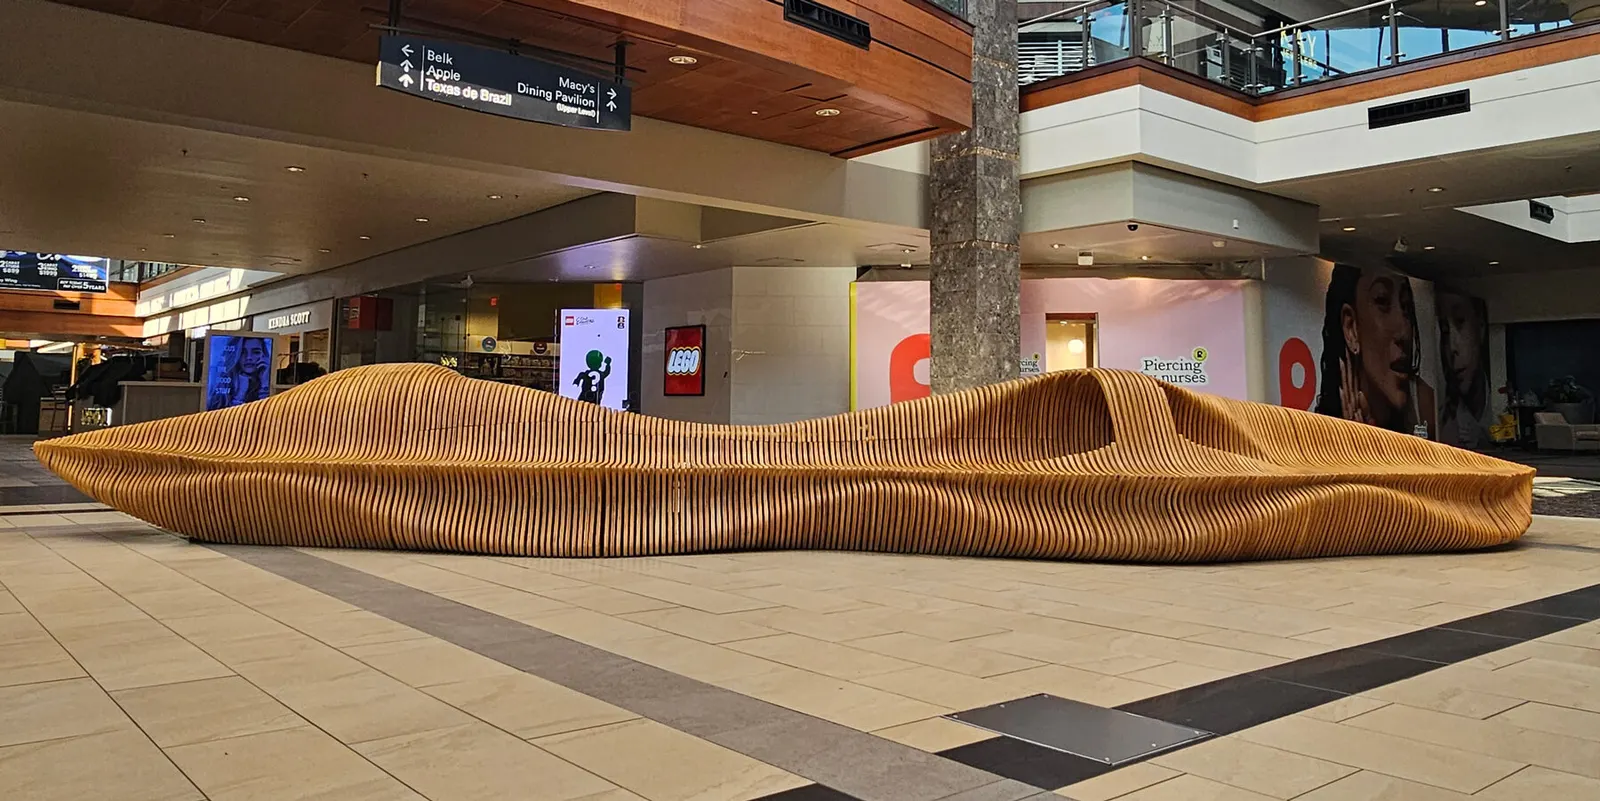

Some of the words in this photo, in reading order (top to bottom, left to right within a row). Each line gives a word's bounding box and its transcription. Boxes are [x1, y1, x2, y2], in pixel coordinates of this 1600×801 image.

[427, 50, 453, 65] Belk
[426, 65, 461, 81] Apple
[425, 78, 460, 96] Texas
[462, 86, 479, 100] de
[480, 88, 512, 106] Brazil
[559, 77, 595, 94] Macy's
[517, 82, 553, 101] Dining
[555, 90, 595, 107] Pavilion
[556, 102, 578, 114] (Upper
[290, 311, 311, 326] SCOTT
[666, 348, 702, 375] LEGO
[1144, 358, 1203, 374] Piercing
[1161, 374, 1206, 383] nurses
